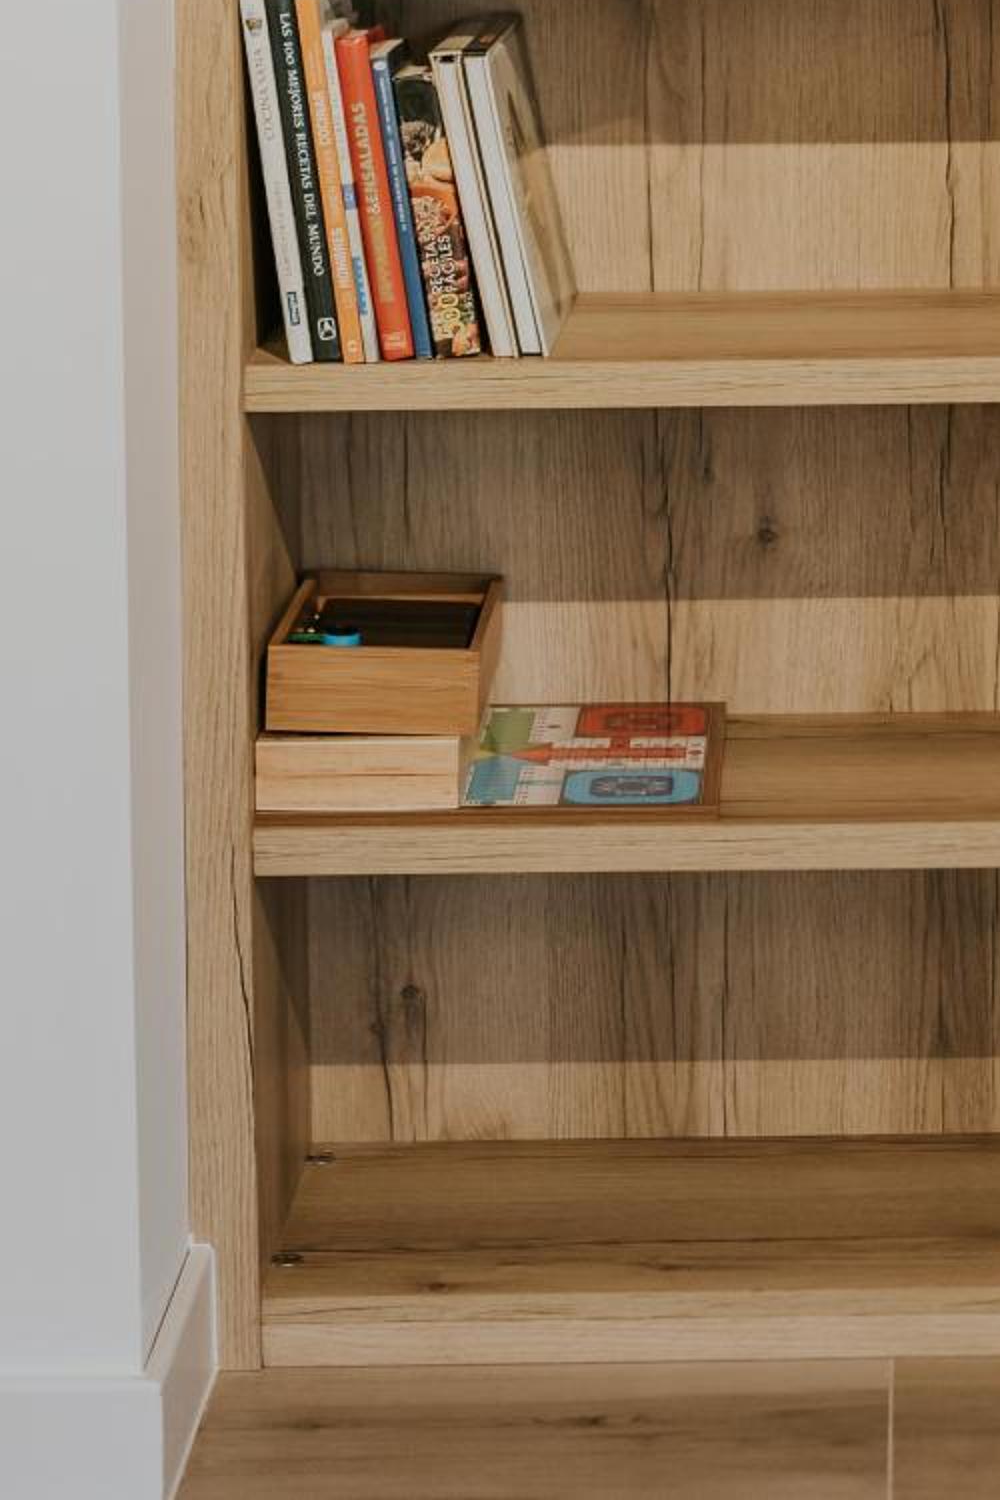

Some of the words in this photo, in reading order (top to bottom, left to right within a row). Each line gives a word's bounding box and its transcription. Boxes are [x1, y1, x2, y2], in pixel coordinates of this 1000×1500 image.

[280, 13, 293, 38] LAS
[286, 69, 305, 128] MEJORES
[296, 133, 313, 189] RECETAS
[303, 192, 317, 221] DEL
[307, 226, 325, 277] MUNDO
